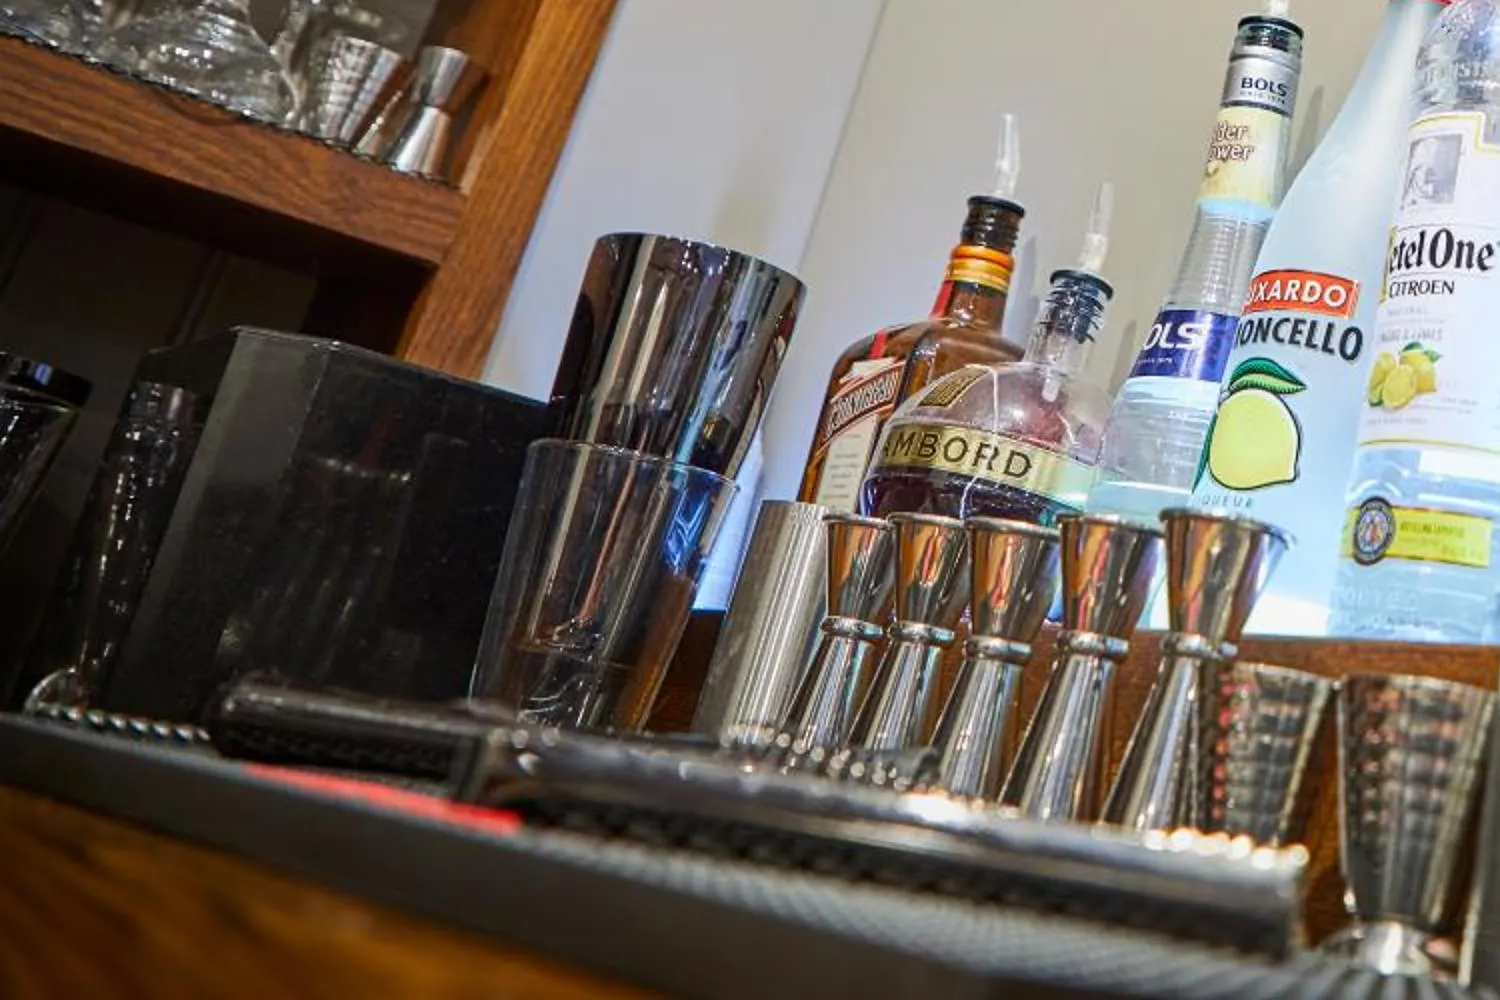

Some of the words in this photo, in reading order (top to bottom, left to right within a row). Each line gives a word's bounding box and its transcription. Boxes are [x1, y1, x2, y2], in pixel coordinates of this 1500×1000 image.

[1241, 77, 1289, 97] BOLS
[1389, 229, 1426, 274] etel
[1429, 227, 1495, 272] One
[1248, 277, 1347, 307] UXARDO
[1389, 279, 1455, 299] CITROEN
[1143, 322, 1210, 351] OLS
